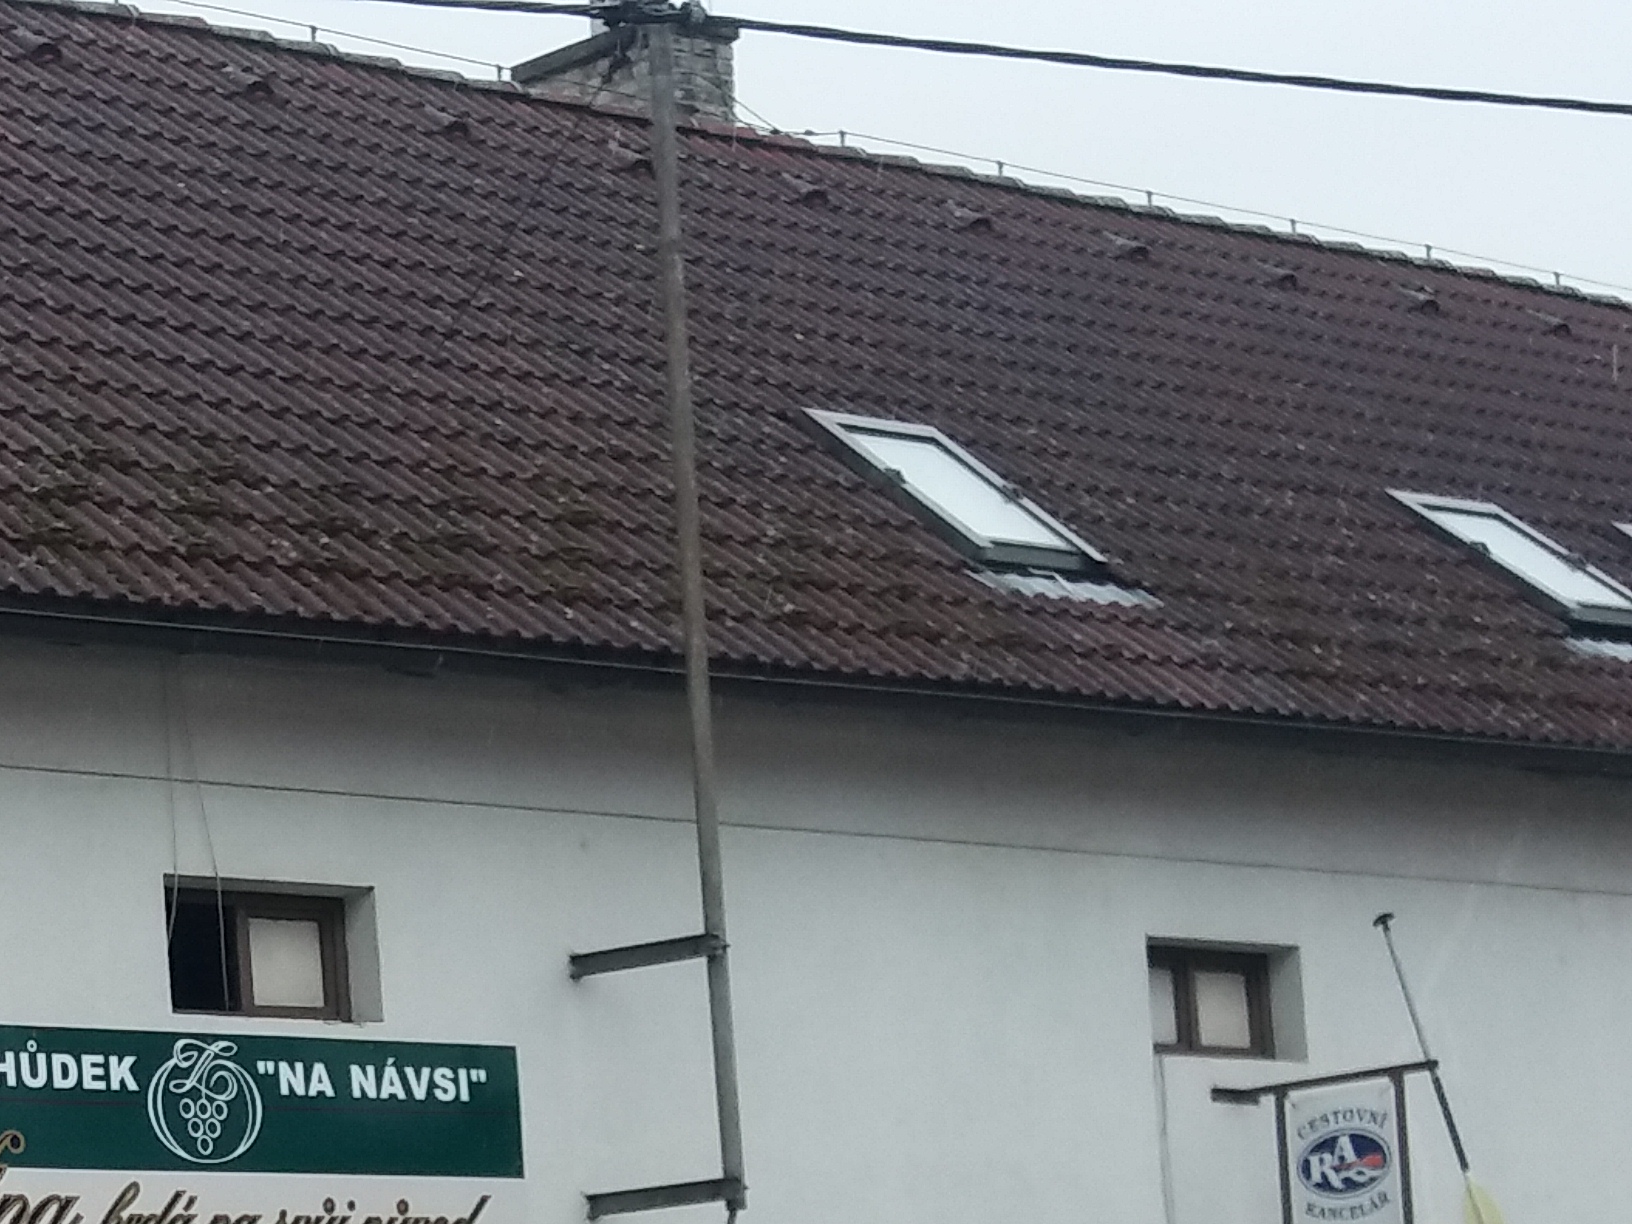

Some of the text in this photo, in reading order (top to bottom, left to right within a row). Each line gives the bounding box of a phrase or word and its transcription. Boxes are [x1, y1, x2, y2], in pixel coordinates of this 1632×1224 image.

[256, 1059, 336, 1098] "NA
[349, 1056, 488, 1103] NÁVSI"
[1297, 1107, 1388, 1140] CESTOVNÍ
[1305, 1190, 1391, 1221] KANCELÁŘ
